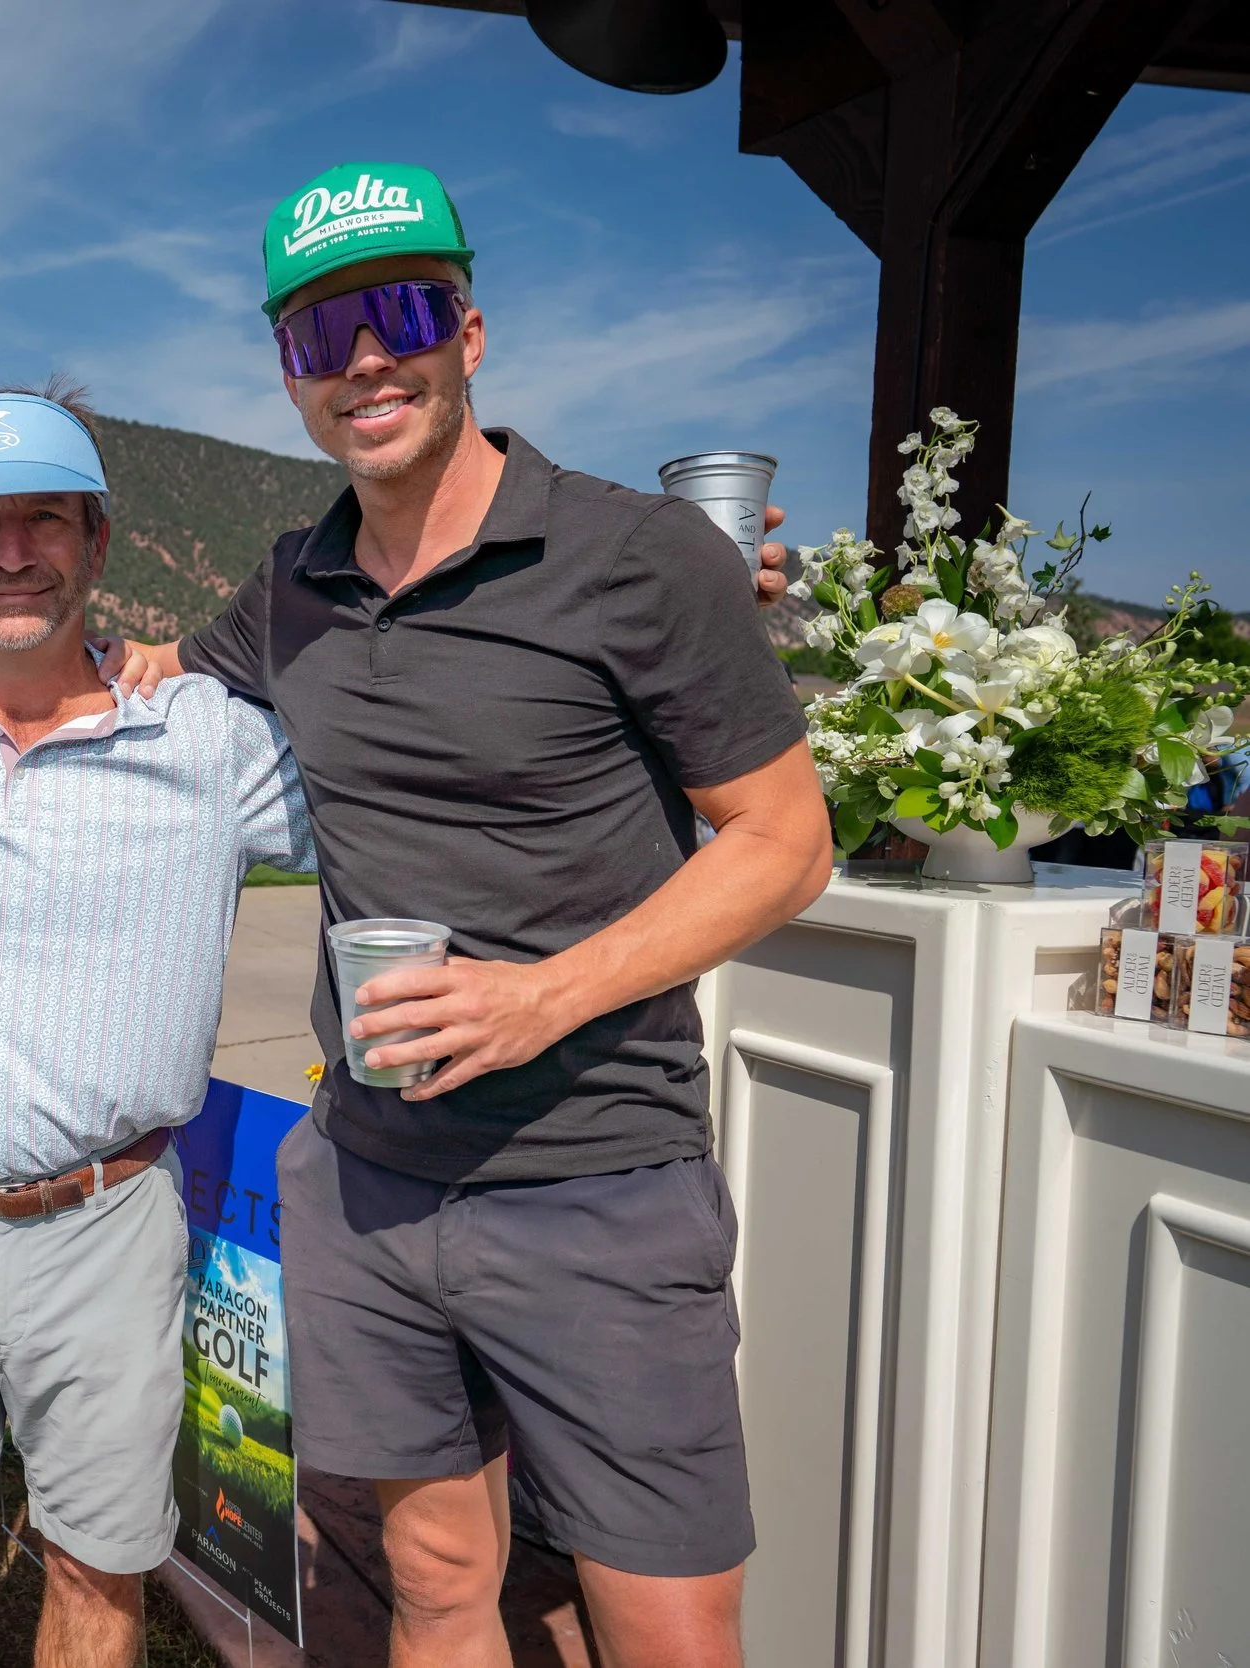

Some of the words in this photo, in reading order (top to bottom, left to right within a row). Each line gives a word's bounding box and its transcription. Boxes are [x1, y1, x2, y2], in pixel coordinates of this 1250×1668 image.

[293, 174, 410, 238] Delta
[319, 213, 385, 236] MILLWORKS
[305, 242, 328, 258] SINCE
[357, 226, 392, 237] AUSTIN,
[739, 504, 756, 520] A
[739, 524, 756, 534] AND
[1167, 870, 1181, 908] ALDER
[1181, 867, 1195, 908] TWEED
[1123, 957, 1137, 993] ALDER
[1136, 954, 1150, 995] TWEED
[1197, 969, 1211, 1006] ALDER
[1212, 965, 1226, 1007] TWEED
[191, 1168, 279, 1247] ECTS
[198, 1272, 268, 1325] PARAGON
[200, 1295, 265, 1348] PARTNER
[193, 1317, 270, 1389] GOLF
[196, 1358, 267, 1413] Tournament
[192, 1528, 237, 1572] PARAGON
[254, 1578, 273, 1597] PEAK
[254, 1587, 291, 1621] PROJECTS
